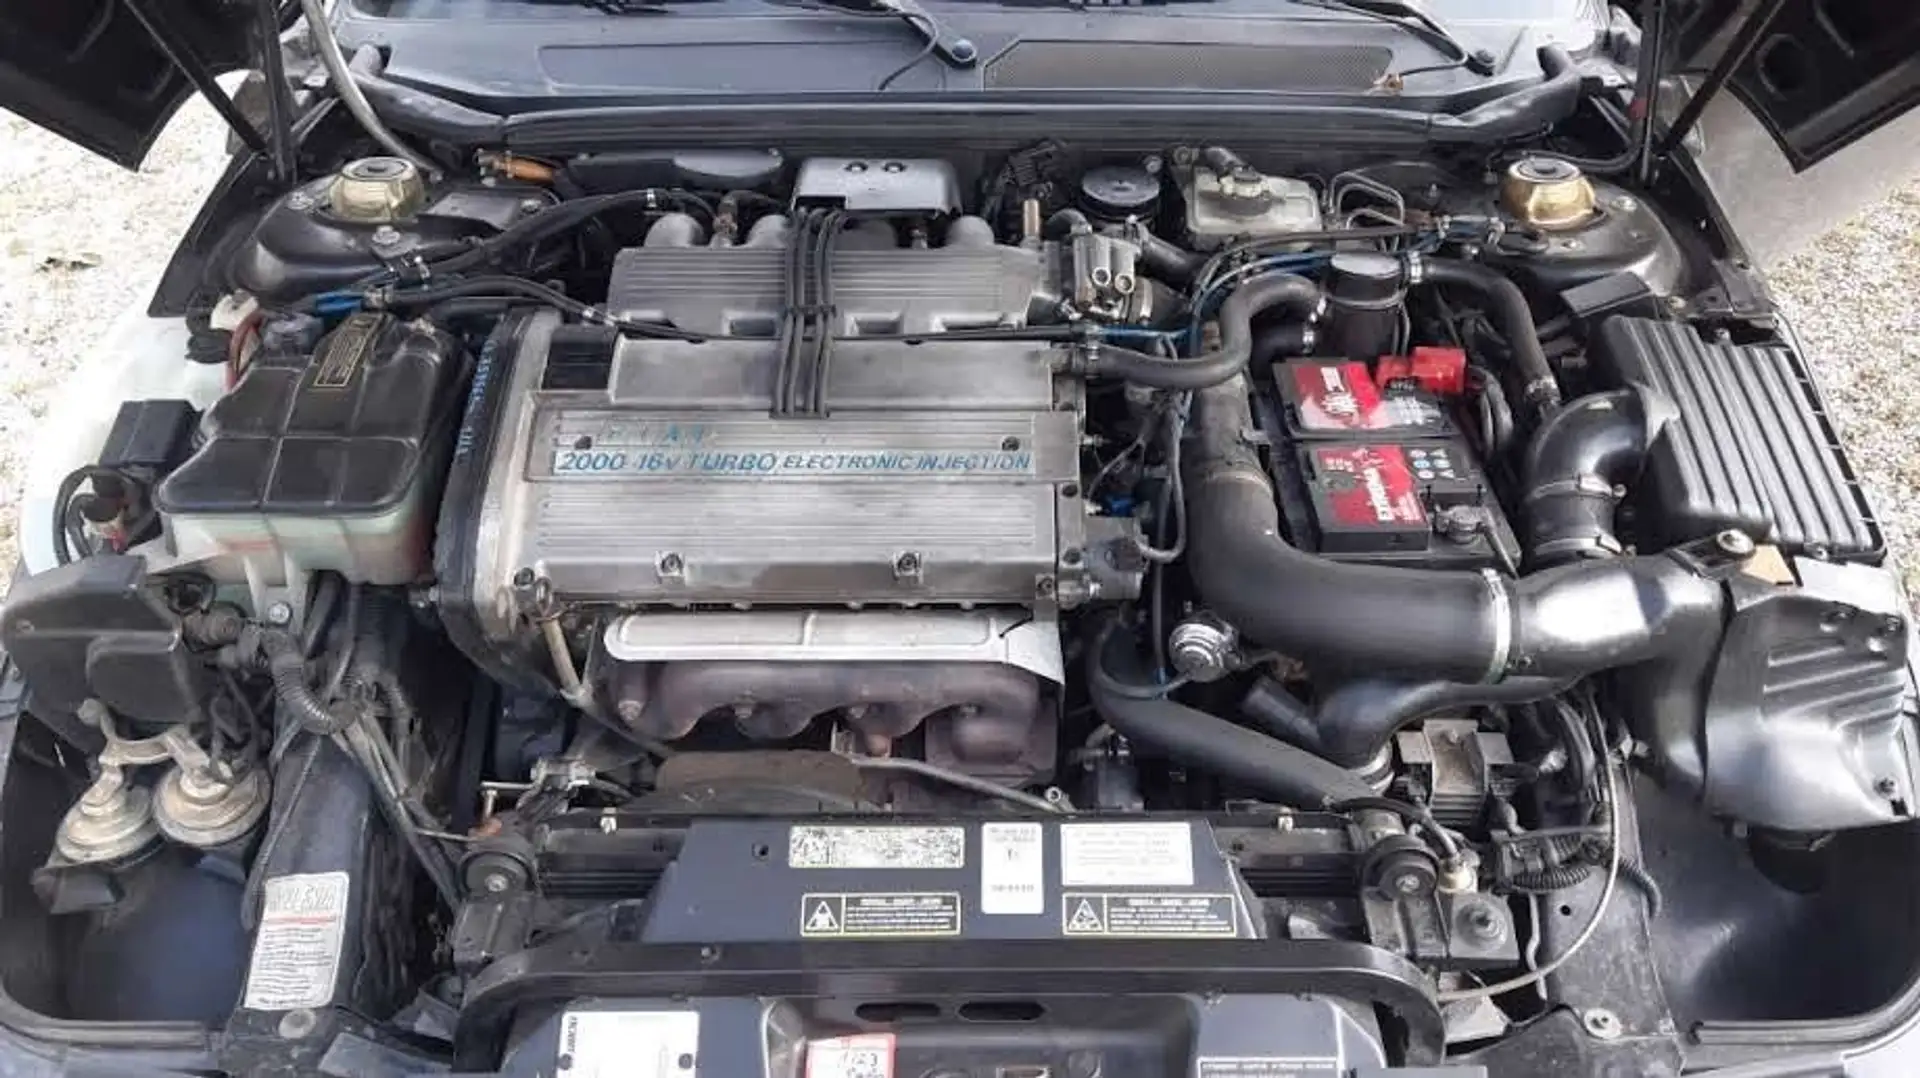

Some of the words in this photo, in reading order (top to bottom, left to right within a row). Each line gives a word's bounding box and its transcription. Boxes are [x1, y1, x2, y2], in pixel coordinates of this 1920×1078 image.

[558, 452, 626, 471] 2000
[689, 453, 777, 472] TURBO
[783, 454, 912, 470] ELECTRONIC
[916, 453, 1030, 470] INJECTION
